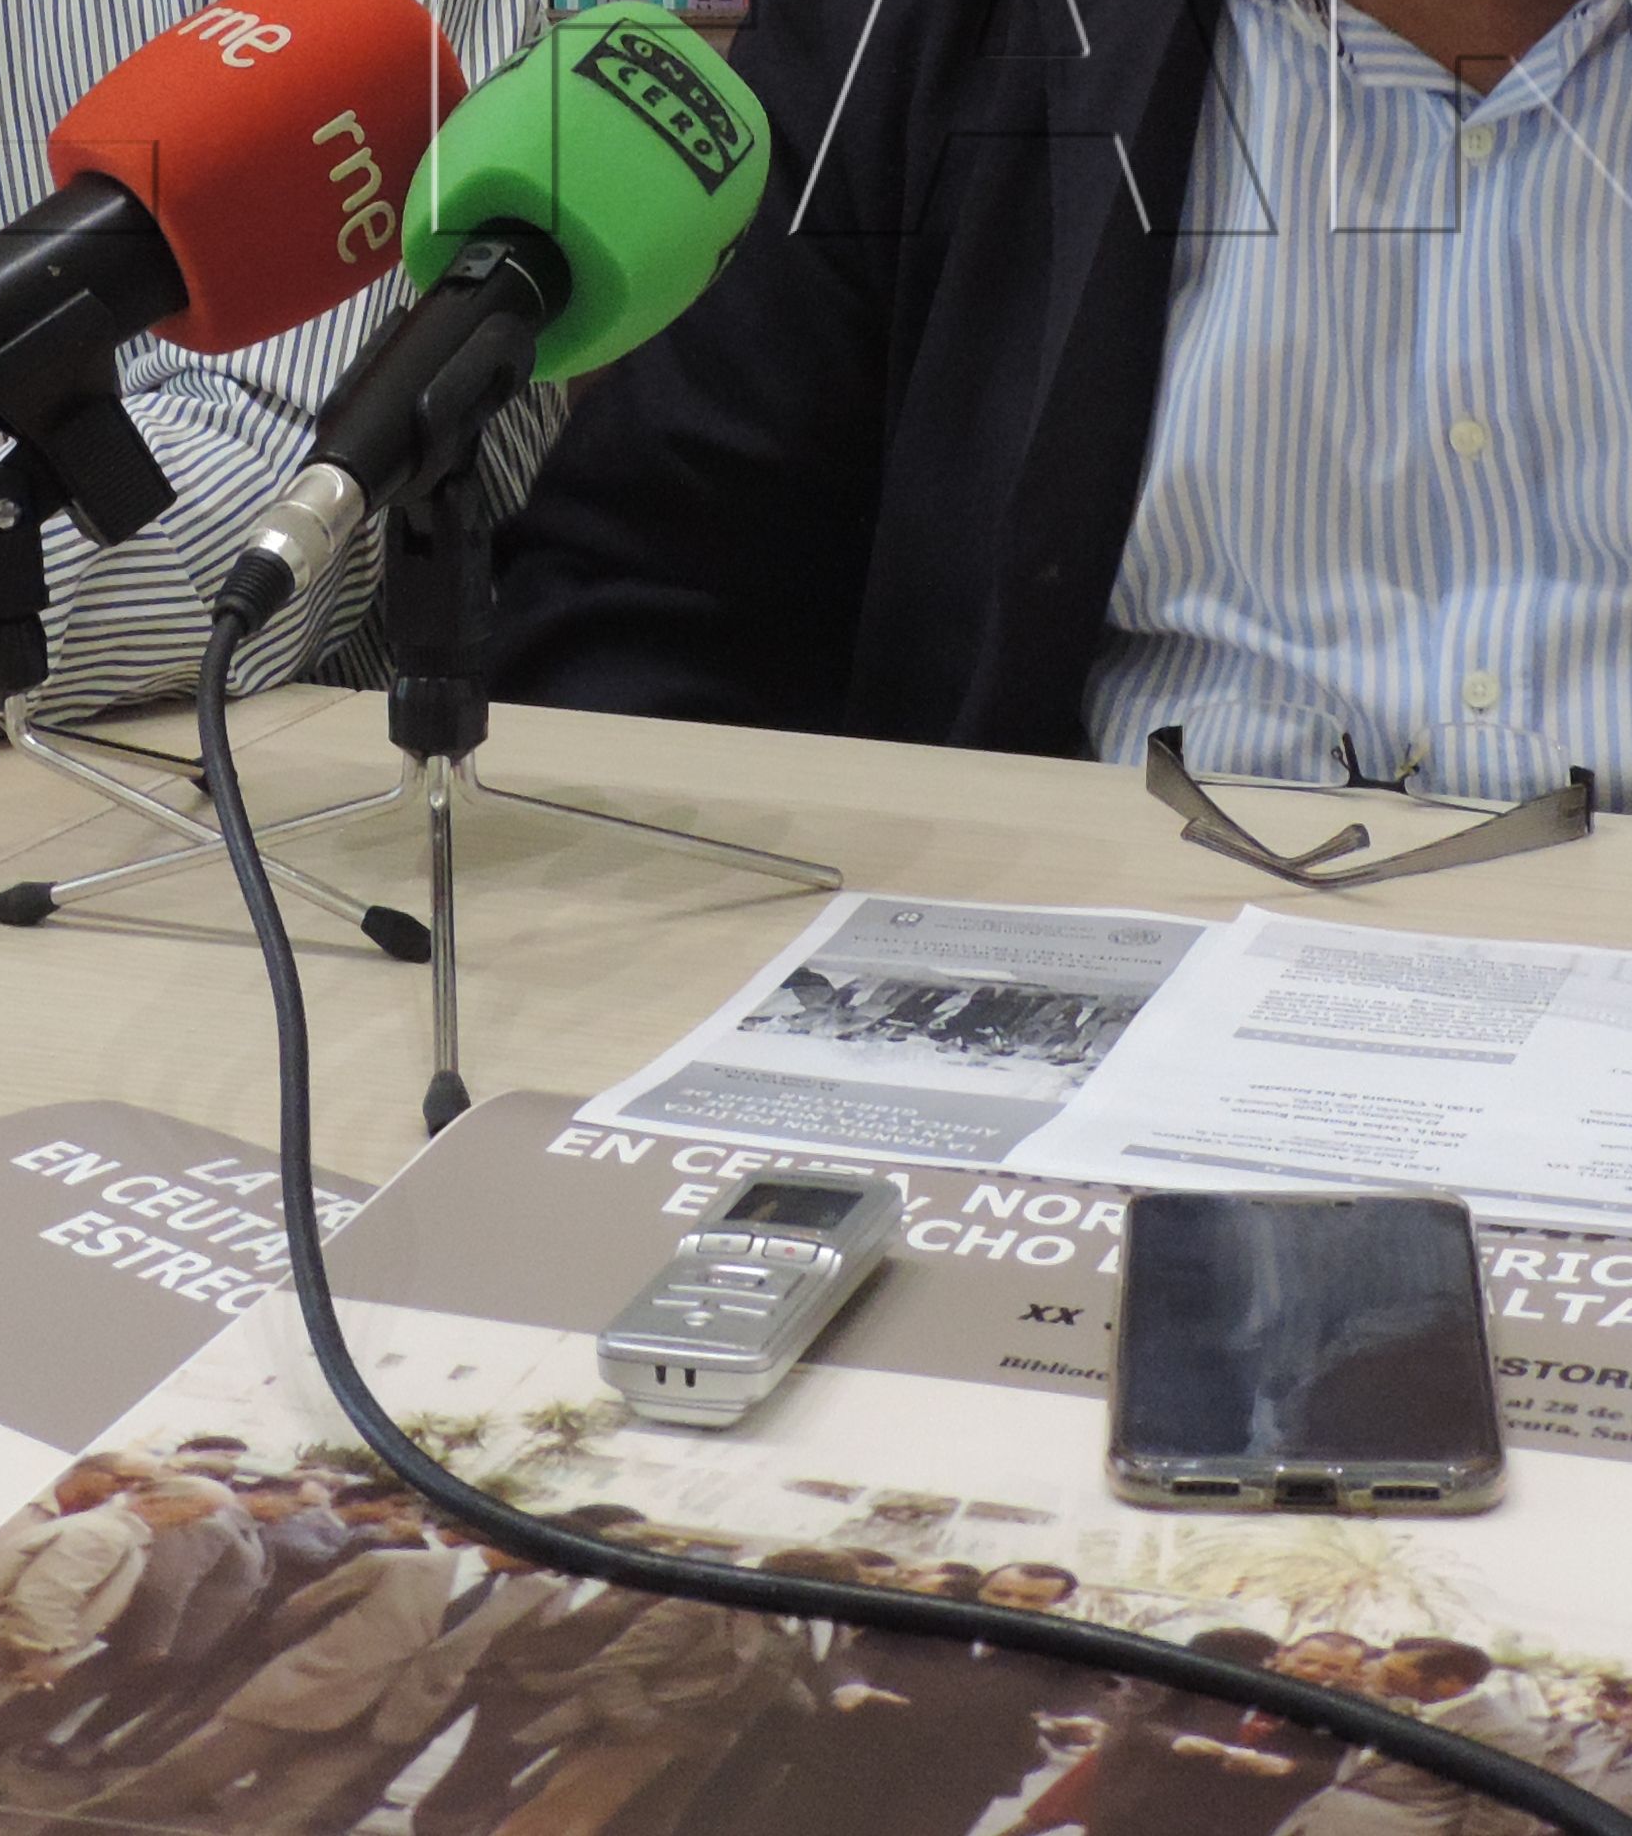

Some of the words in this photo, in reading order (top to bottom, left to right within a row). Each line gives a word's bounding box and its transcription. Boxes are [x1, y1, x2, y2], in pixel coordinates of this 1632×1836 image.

[177, 5, 293, 70] rne
[617, 66, 714, 156] CERO
[625, 35, 735, 141] ONDA
[312, 109, 398, 265] rne
[9, 1139, 122, 1187] EN
[545, 1127, 658, 1165] EN
[1505, 1395, 1537, 1412] al
[1542, 1398, 1579, 1416] 28
[1587, 1403, 1624, 1422] de
